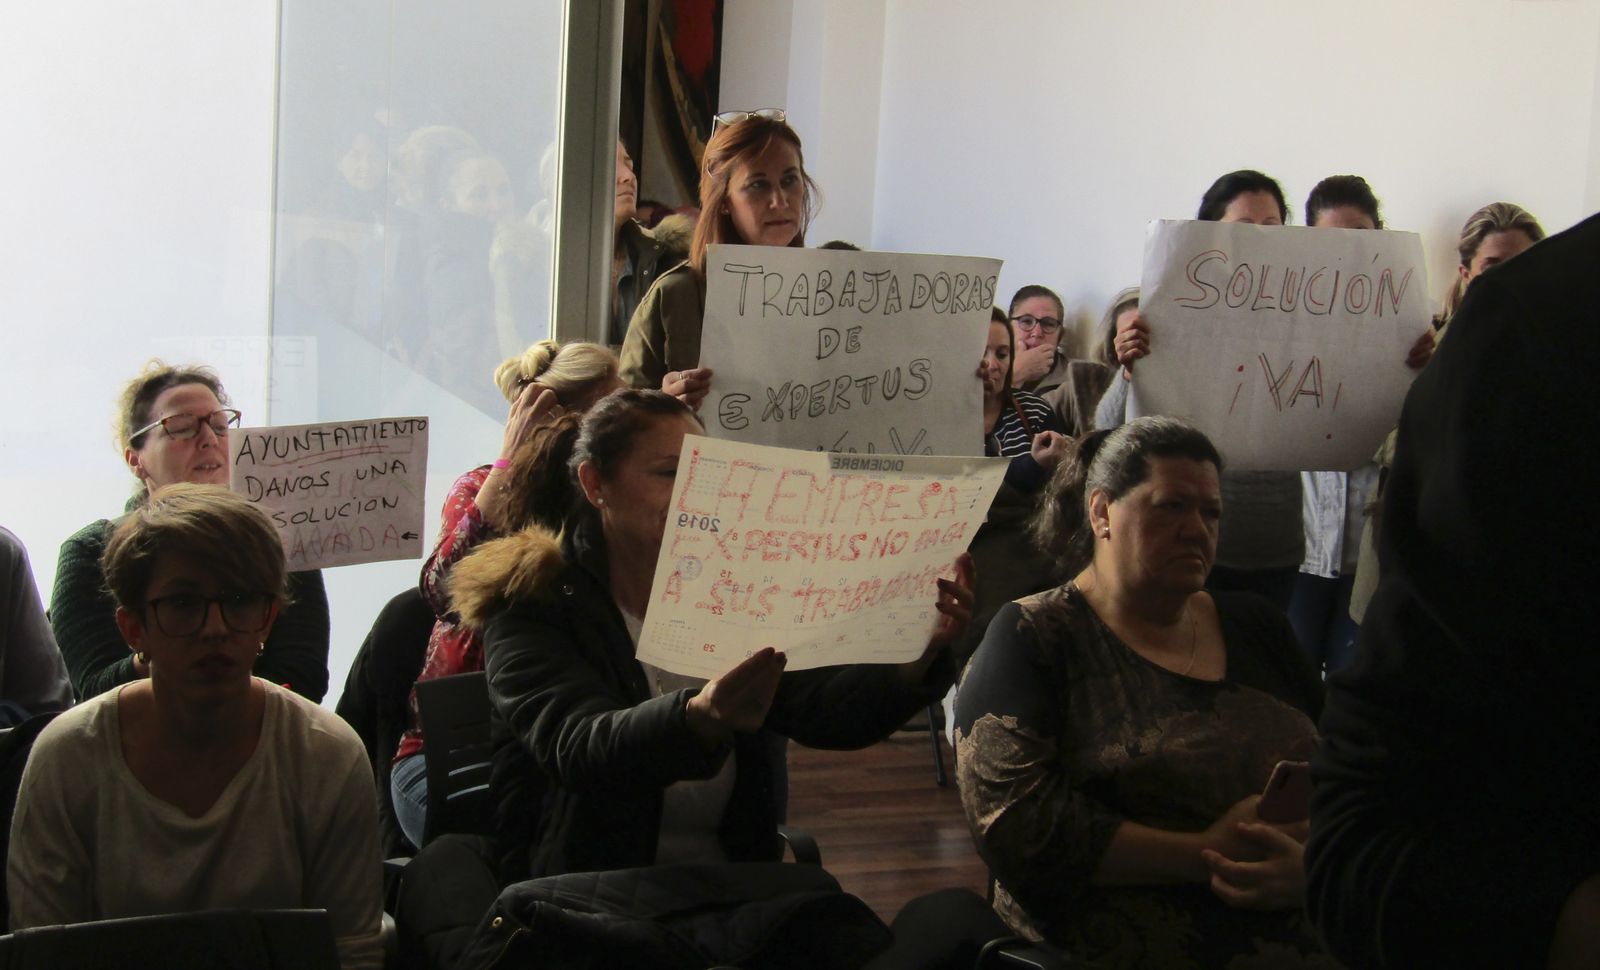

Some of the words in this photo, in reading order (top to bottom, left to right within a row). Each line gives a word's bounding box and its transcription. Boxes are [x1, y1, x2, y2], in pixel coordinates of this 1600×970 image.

[723, 263, 997, 318] TRABAJADORAS
[816, 325, 863, 360] DE
[718, 358, 933, 431] EXPERTUS
[235, 418, 428, 466] AYUNTAMIENTO
[245, 470, 331, 503] DANOS
[356, 459, 407, 481] UNA
[764, 467, 961, 526] EMPRESA
[868, 529, 910, 560] NO
[661, 570, 683, 604] A
[694, 577, 781, 617] SUS
